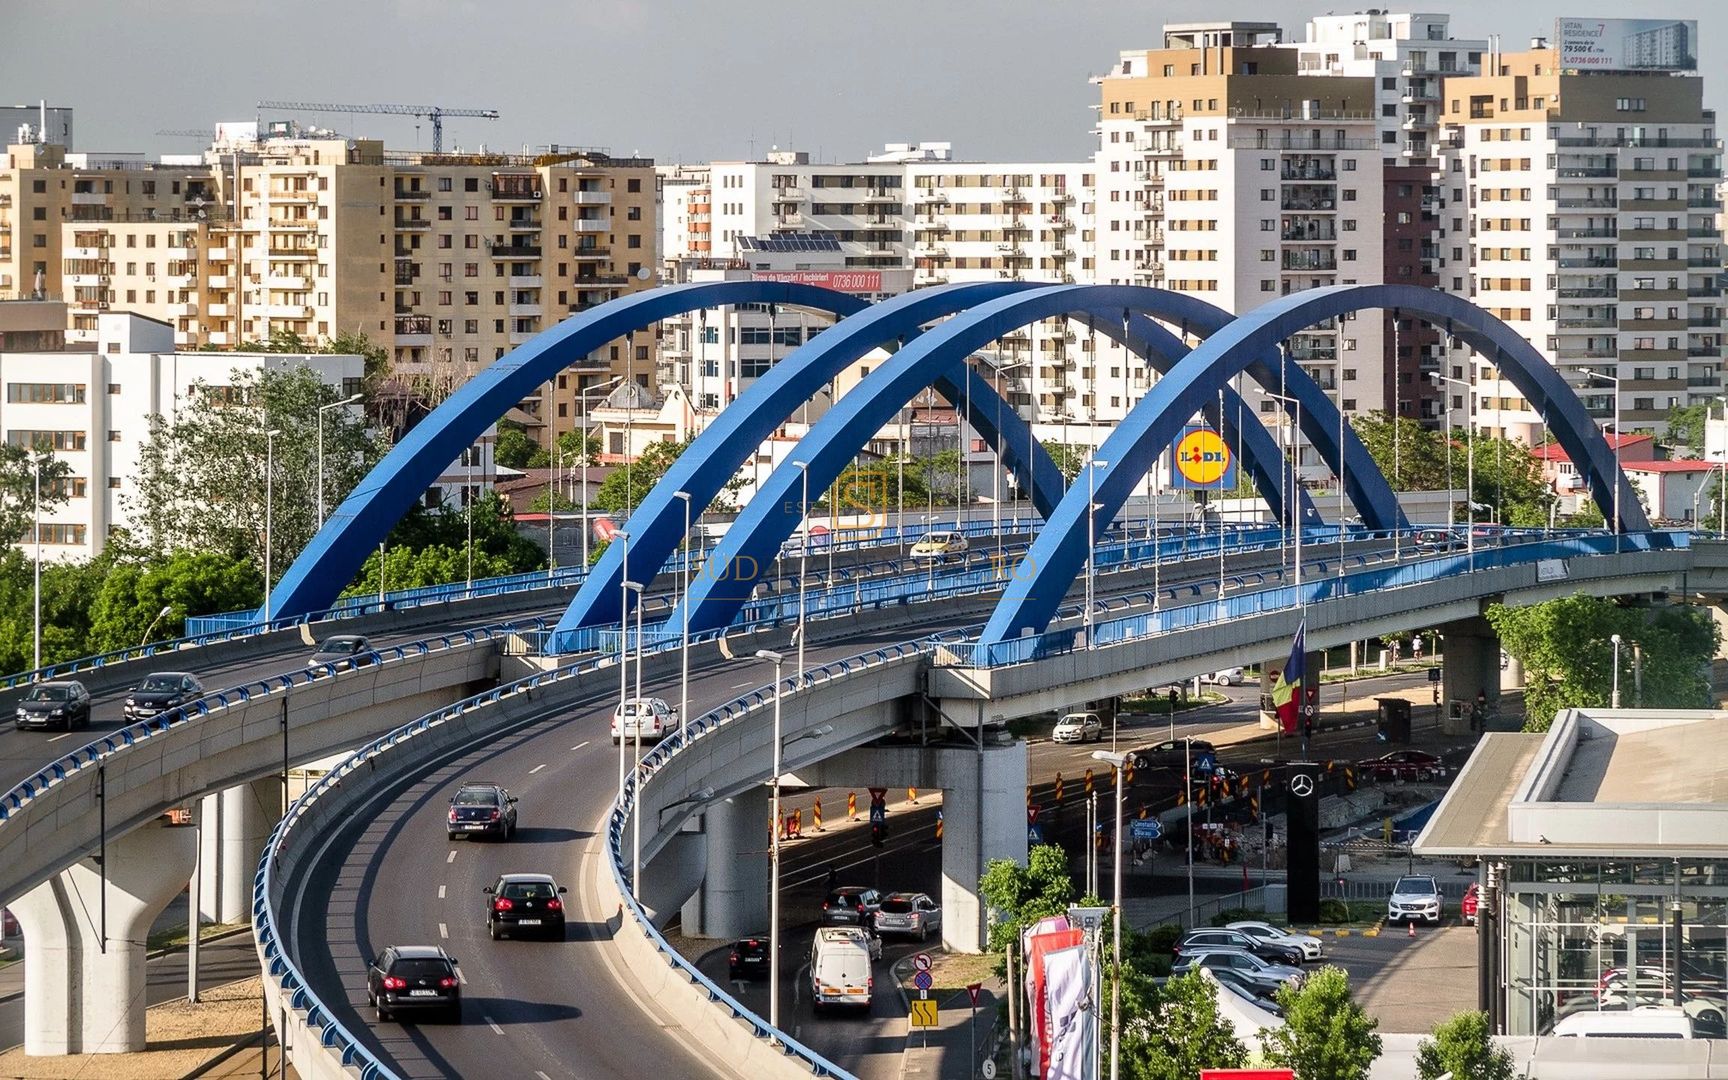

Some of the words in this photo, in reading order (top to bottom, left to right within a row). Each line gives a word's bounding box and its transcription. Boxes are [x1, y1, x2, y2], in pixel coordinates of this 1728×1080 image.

[1598, 24, 1605, 37] 7
[832, 274, 850, 288] 0736
[851, 274, 866, 288] 000
[866, 273, 880, 288] 111
[987, 1064, 992, 1075] 5
